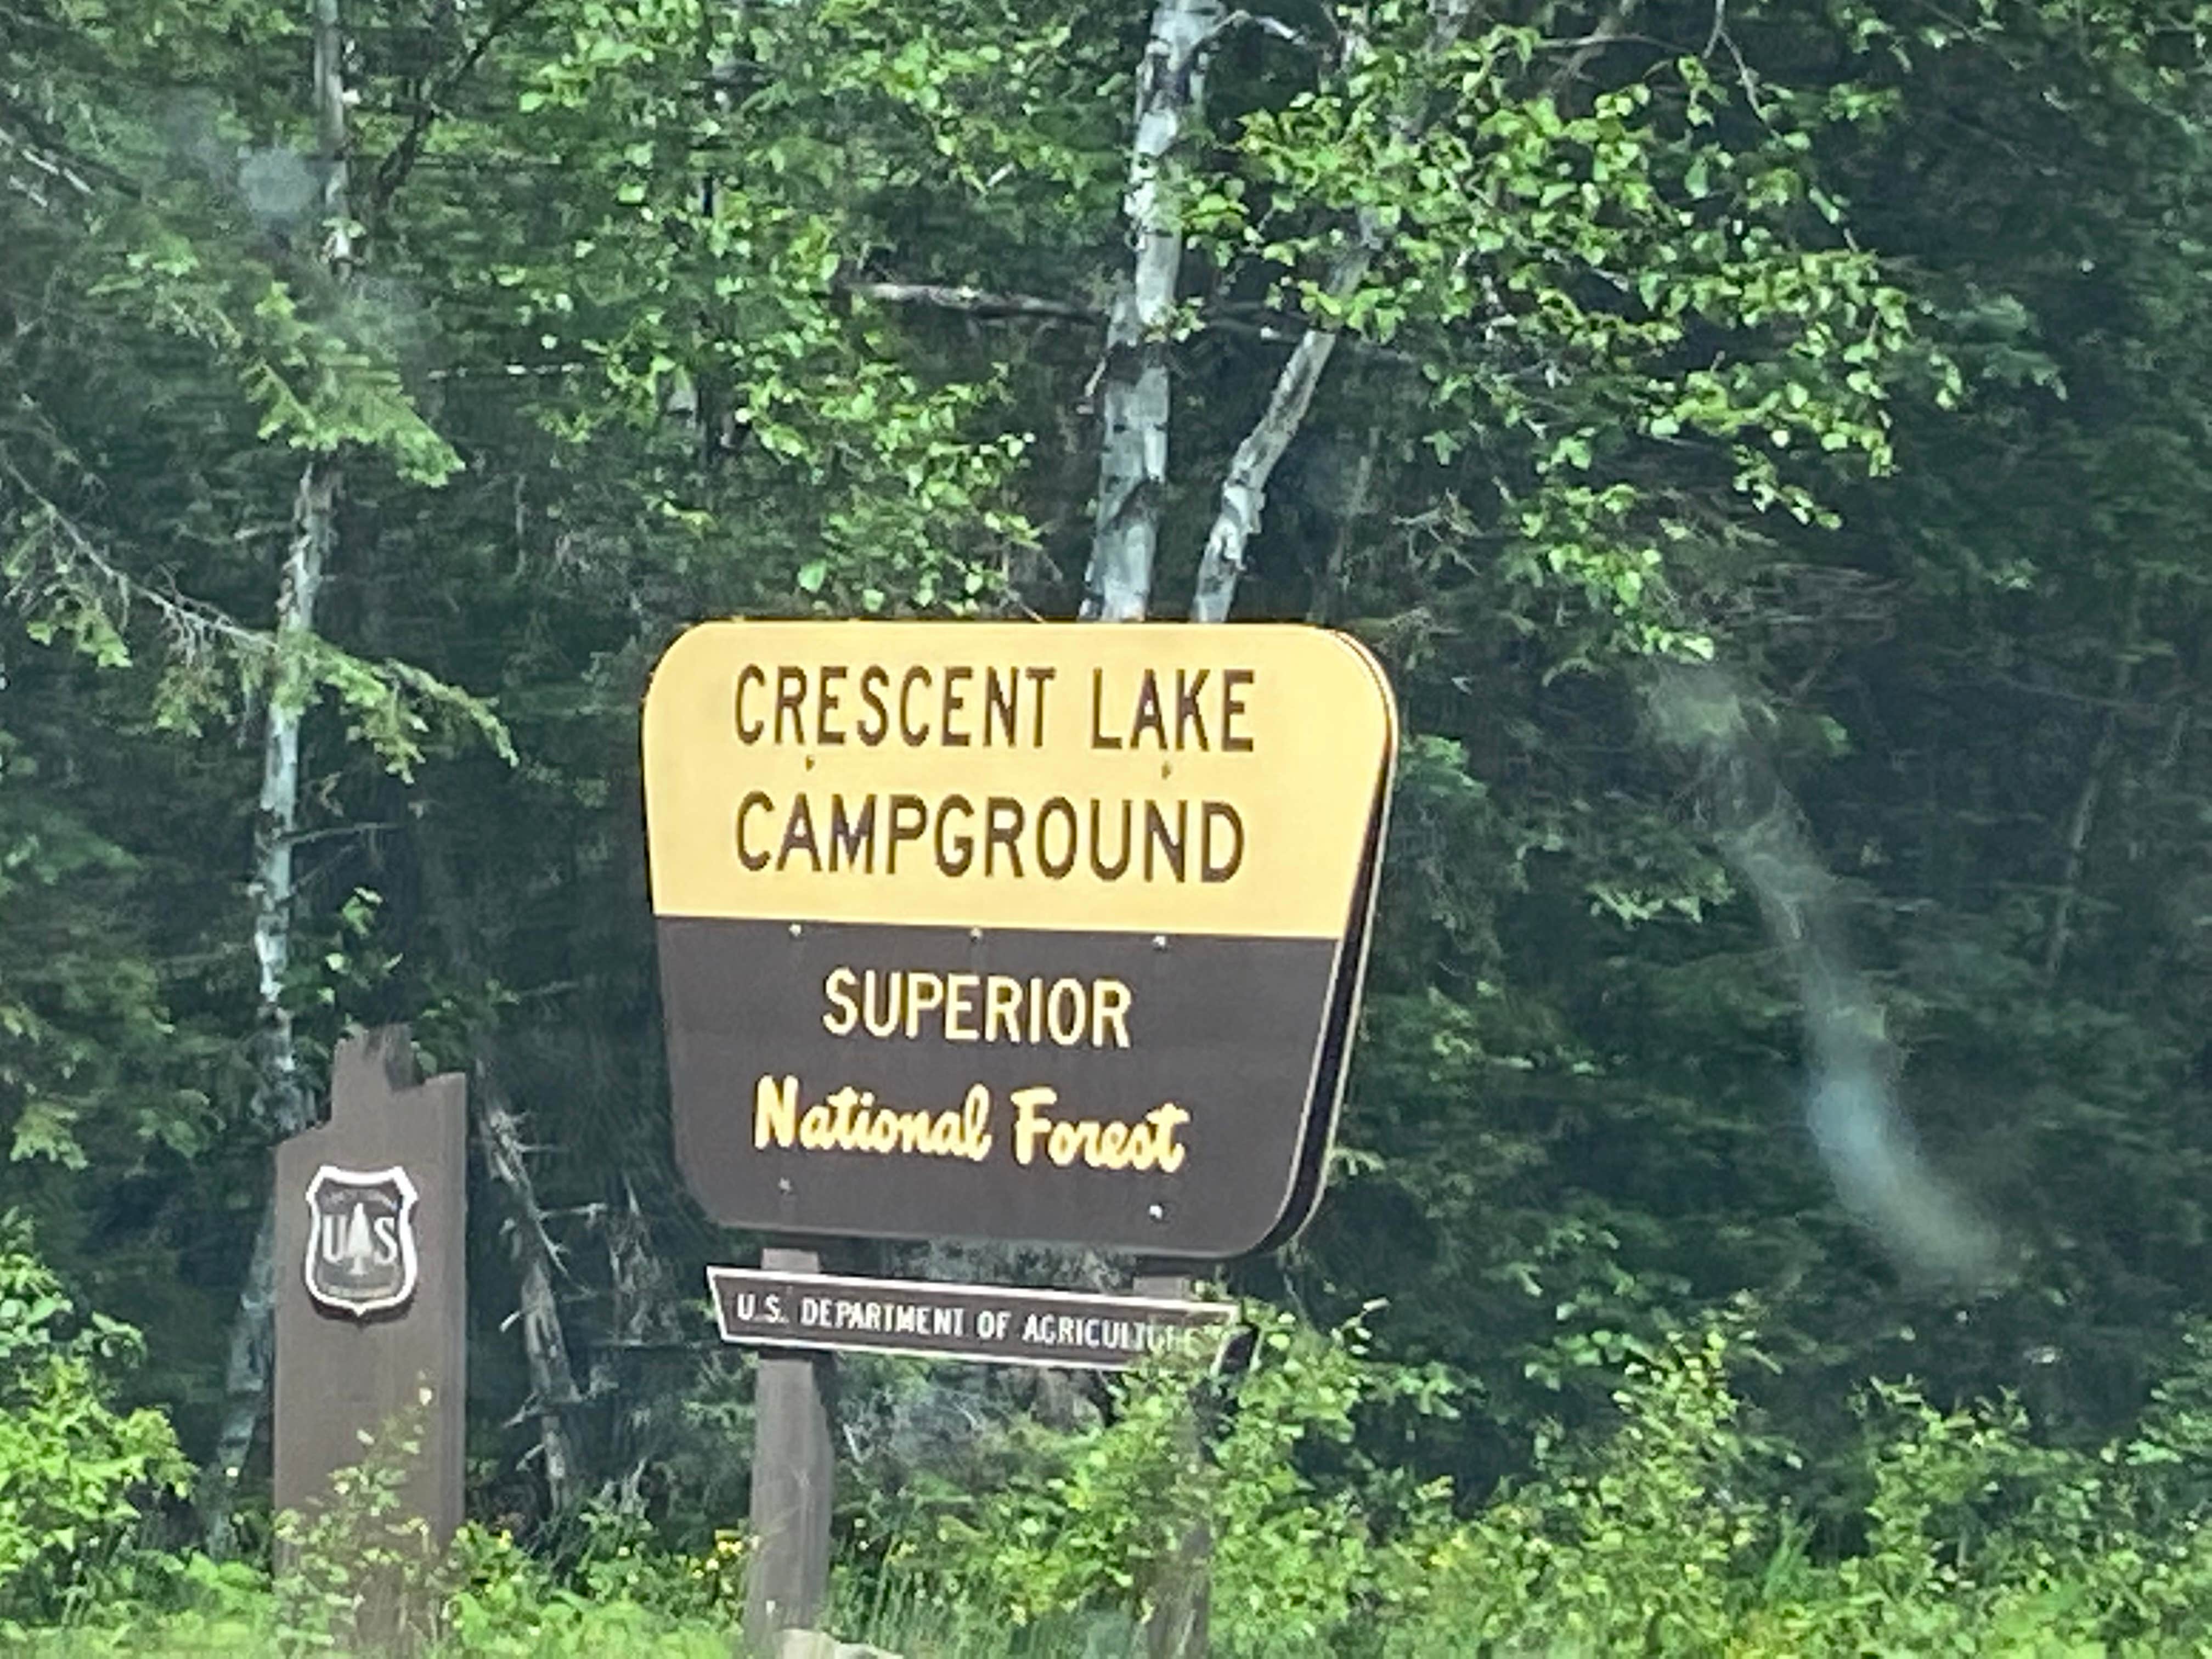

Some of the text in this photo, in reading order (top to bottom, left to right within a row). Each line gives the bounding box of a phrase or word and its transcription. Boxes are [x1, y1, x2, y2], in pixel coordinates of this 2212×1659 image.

[735, 664, 1256, 753] CRESCENT LAKE
[736, 791, 1245, 884] CAMPGROUND
[823, 967, 1132, 1048] SUPERIOR
[753, 1074, 1192, 1173] National Forest
[736, 1293, 1205, 1358] U.S. DEPARTMENT OF AGRICULTU
